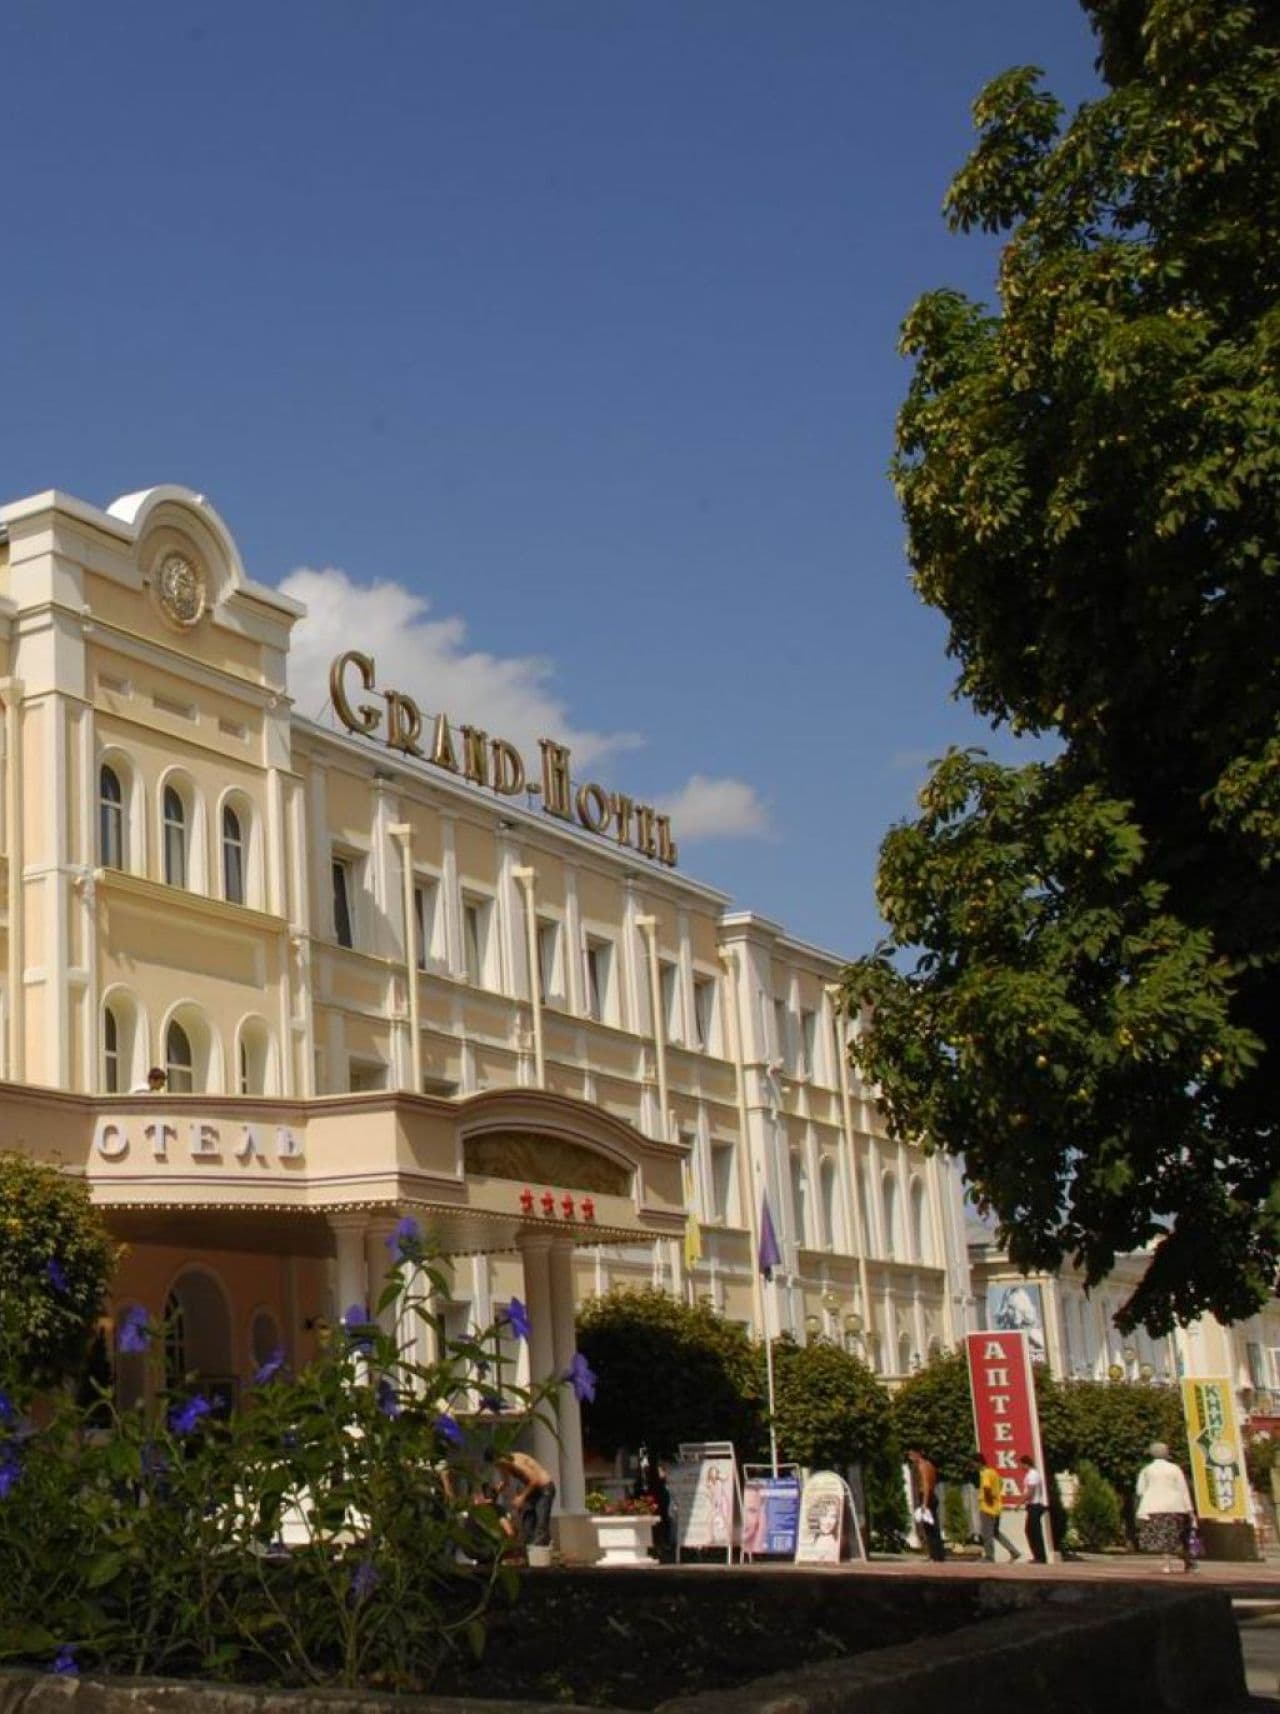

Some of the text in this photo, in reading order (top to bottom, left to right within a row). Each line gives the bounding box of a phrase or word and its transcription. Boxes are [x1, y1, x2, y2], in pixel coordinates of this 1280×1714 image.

[329, 650, 679, 867] GRAND-HOTEL
[94, 1121, 307, 1160] ОТЕЛЬ
[983, 1340, 1022, 1496] АПТЕКА
